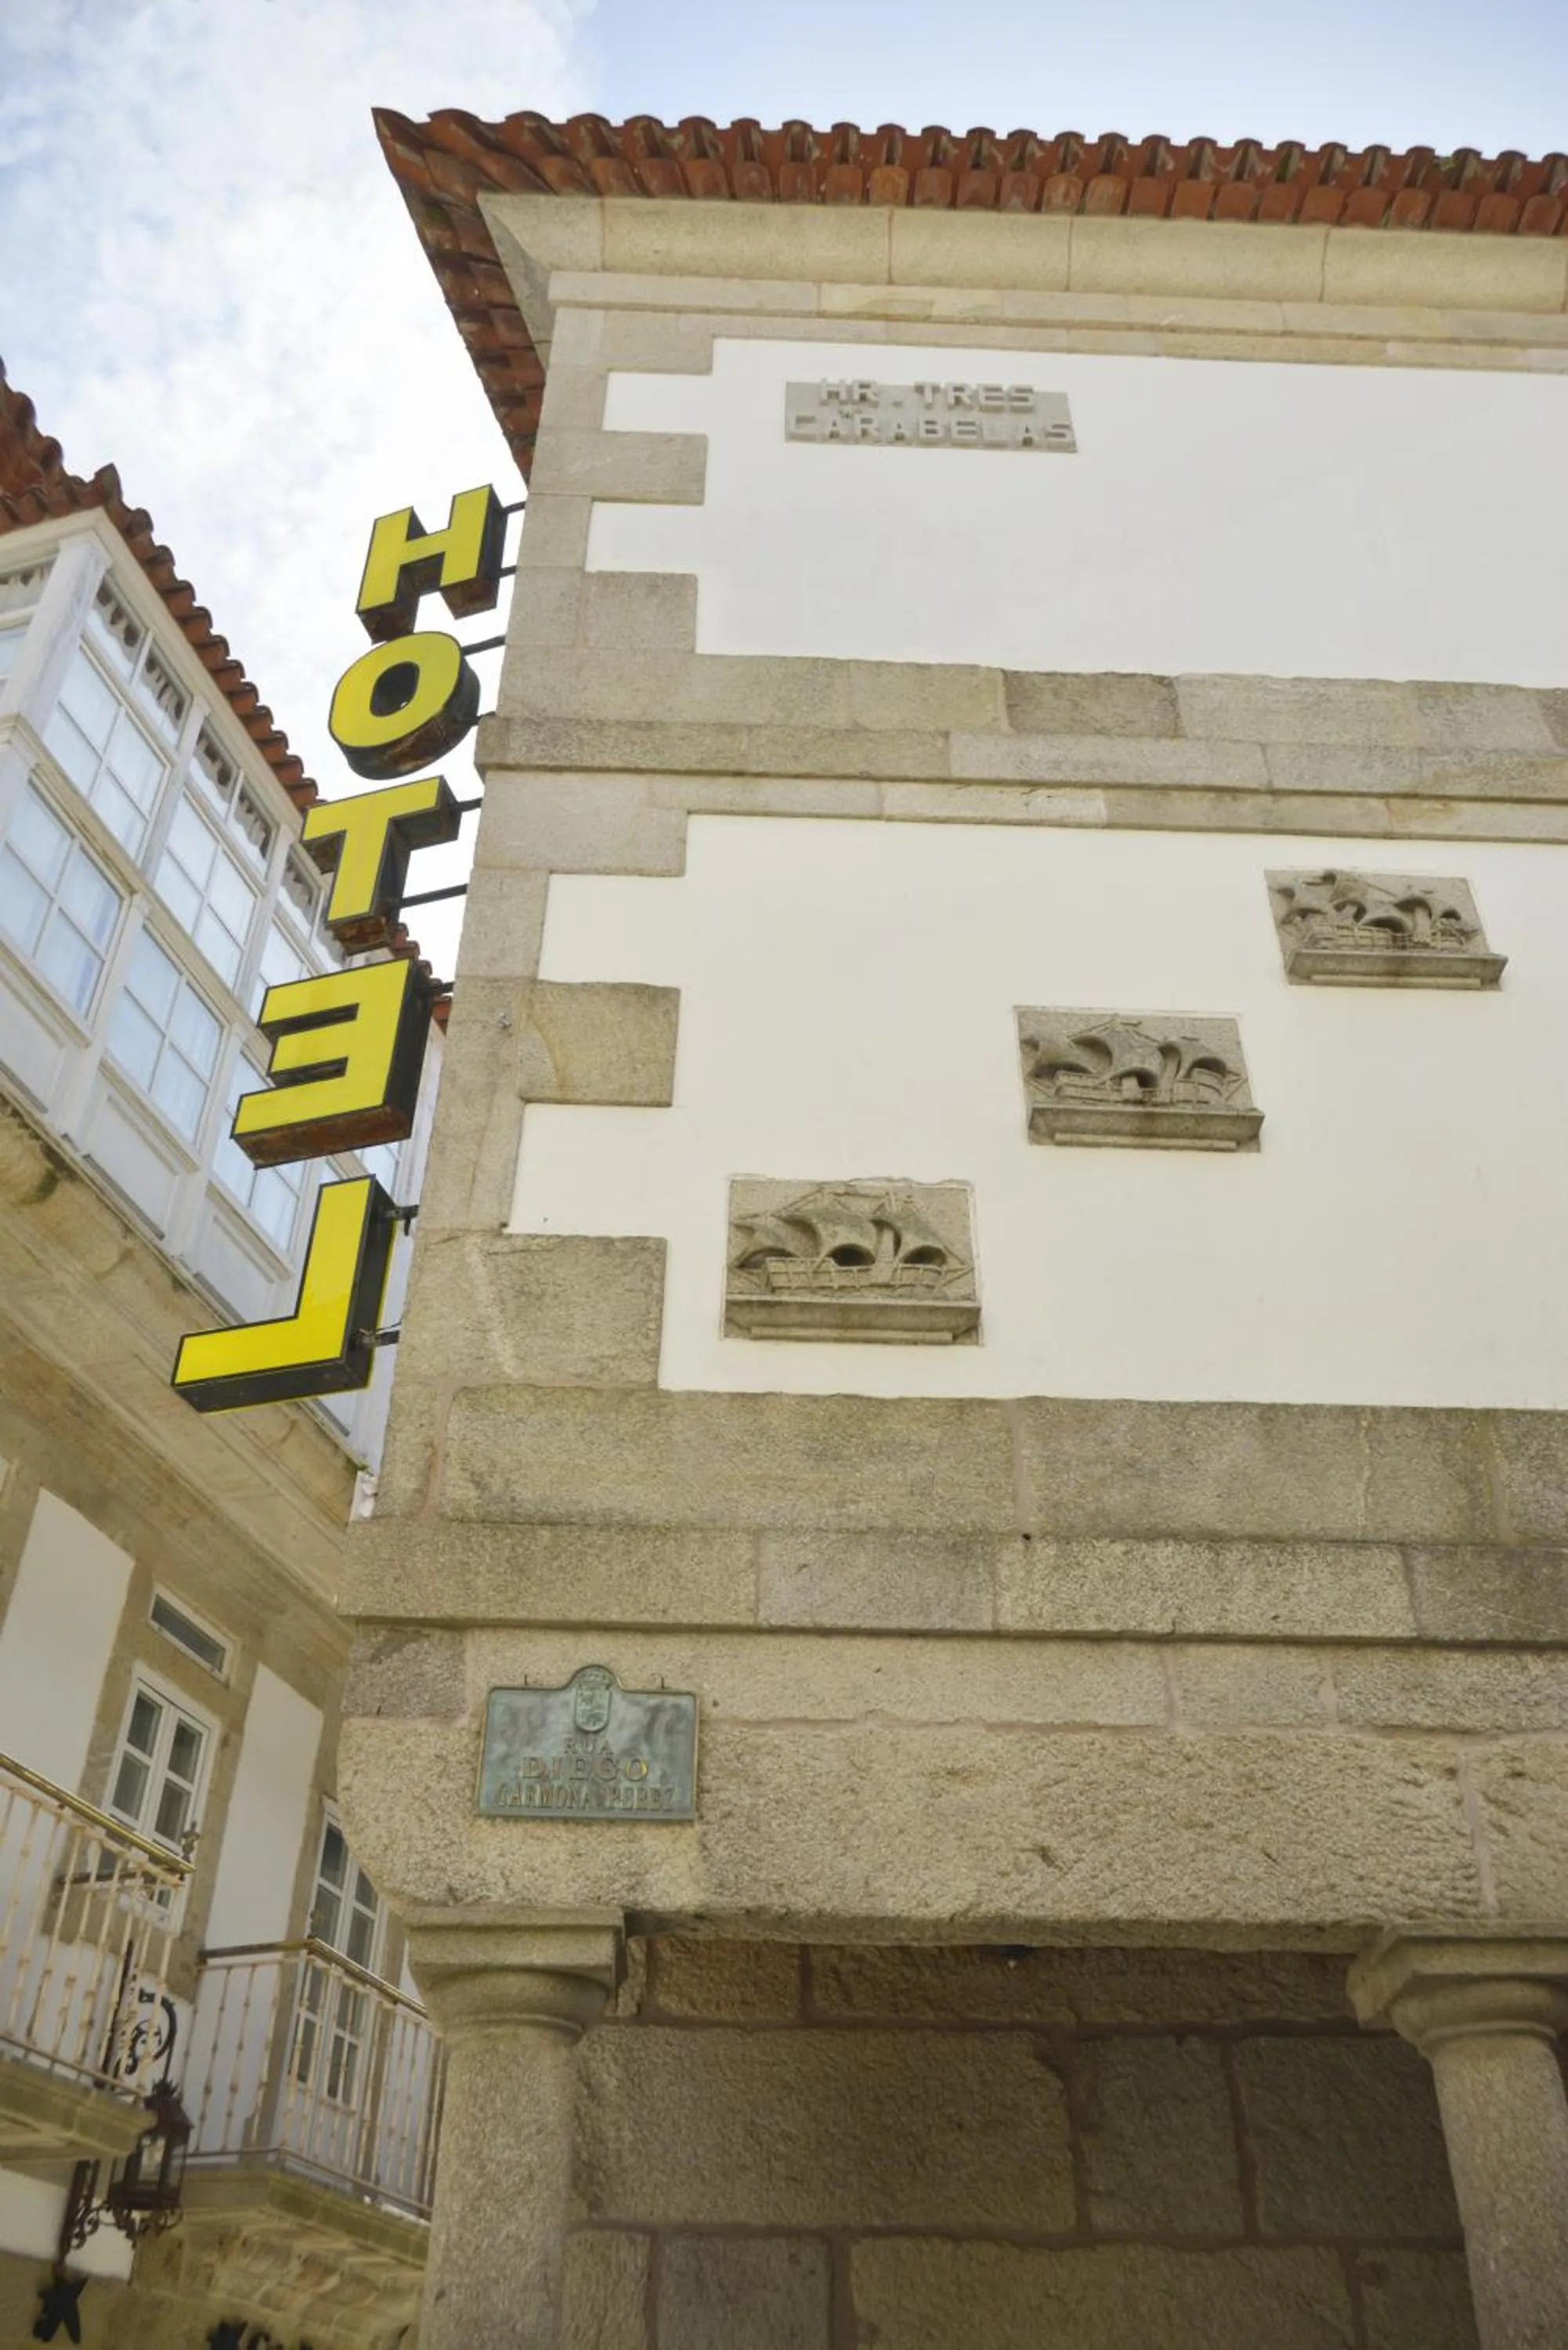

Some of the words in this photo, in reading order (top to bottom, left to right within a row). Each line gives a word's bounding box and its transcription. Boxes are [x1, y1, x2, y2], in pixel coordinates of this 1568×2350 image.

[914, 382, 1035, 413] TRES
[788, 410, 1075, 452] CARABELAS
[522, 1756, 649, 1783] DIEGO
